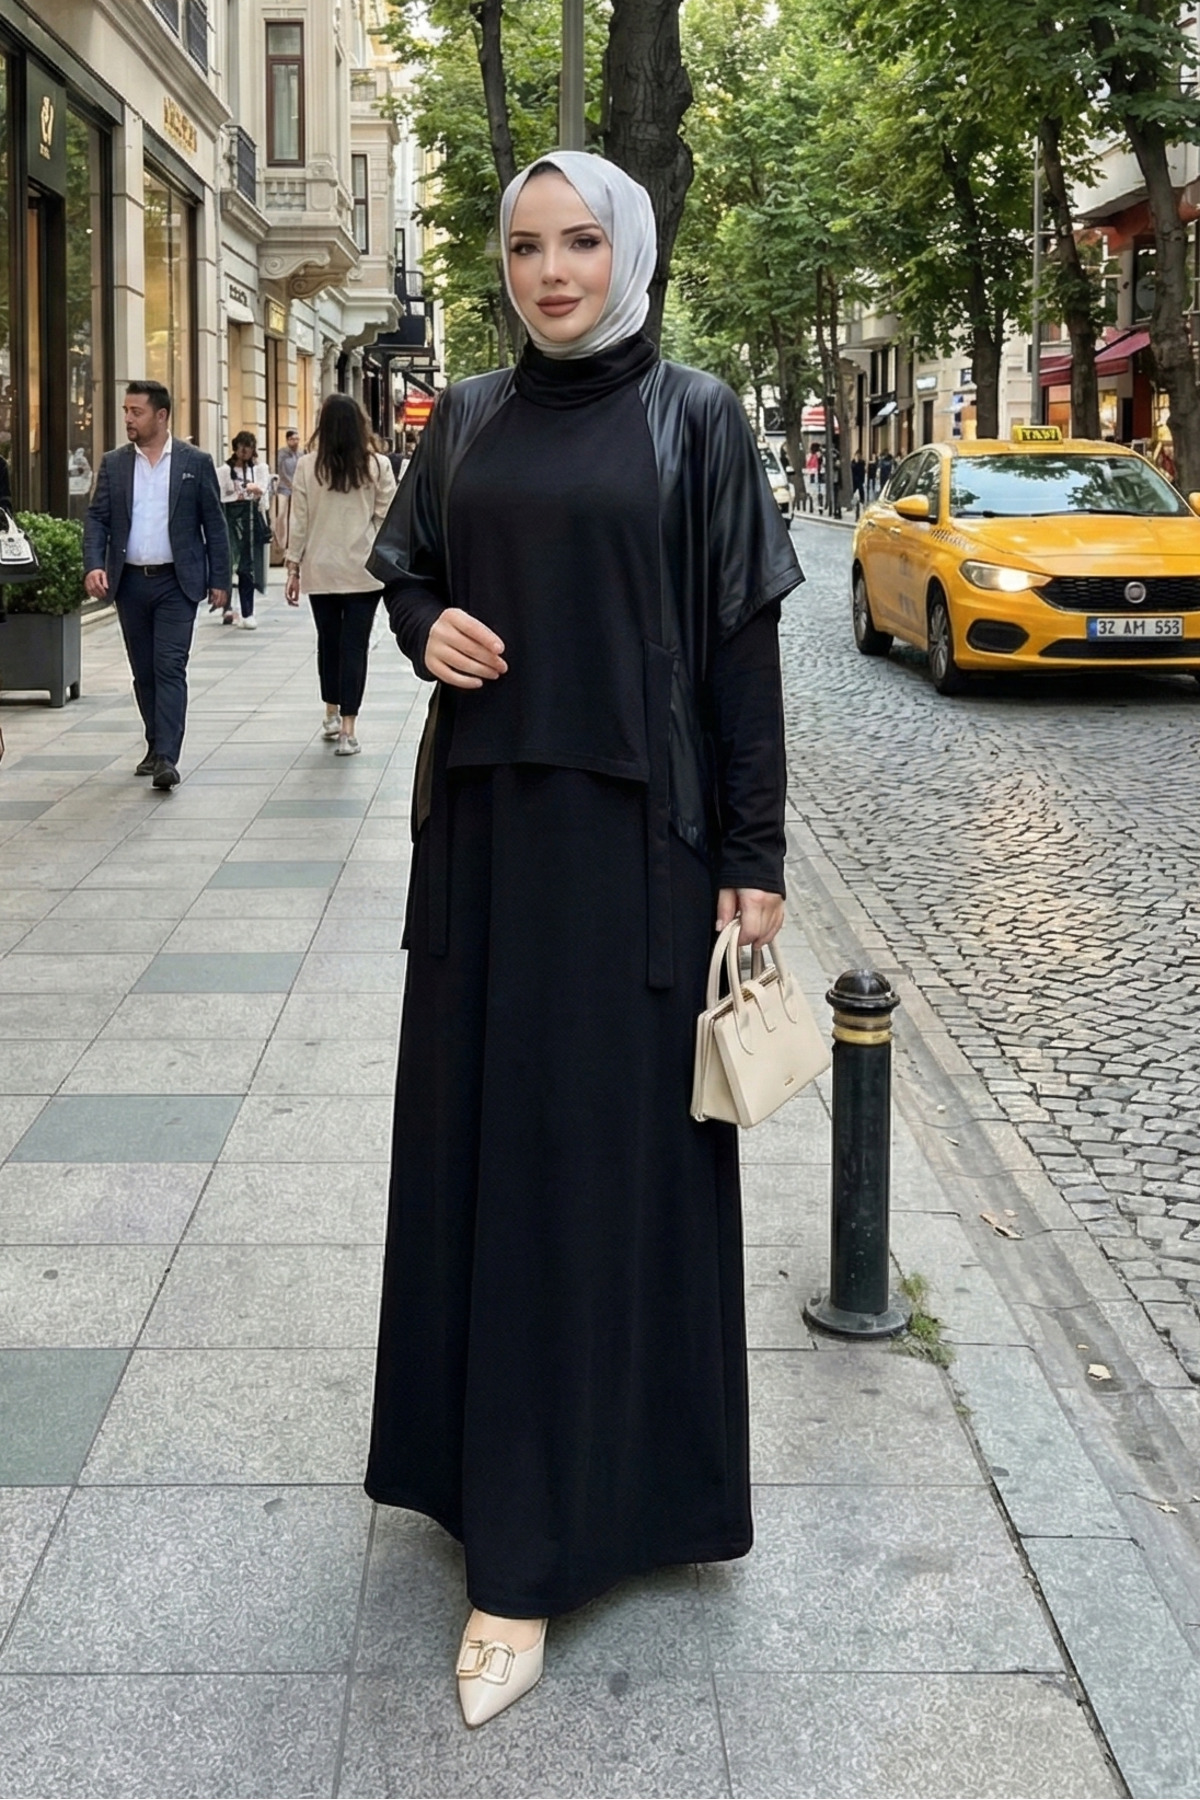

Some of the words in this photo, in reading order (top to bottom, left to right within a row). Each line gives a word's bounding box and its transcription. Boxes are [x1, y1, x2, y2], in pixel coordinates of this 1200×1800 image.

[1098, 620, 1115, 635] 32
[1123, 620, 1145, 635] AM
[1155, 620, 1180, 635] 553
